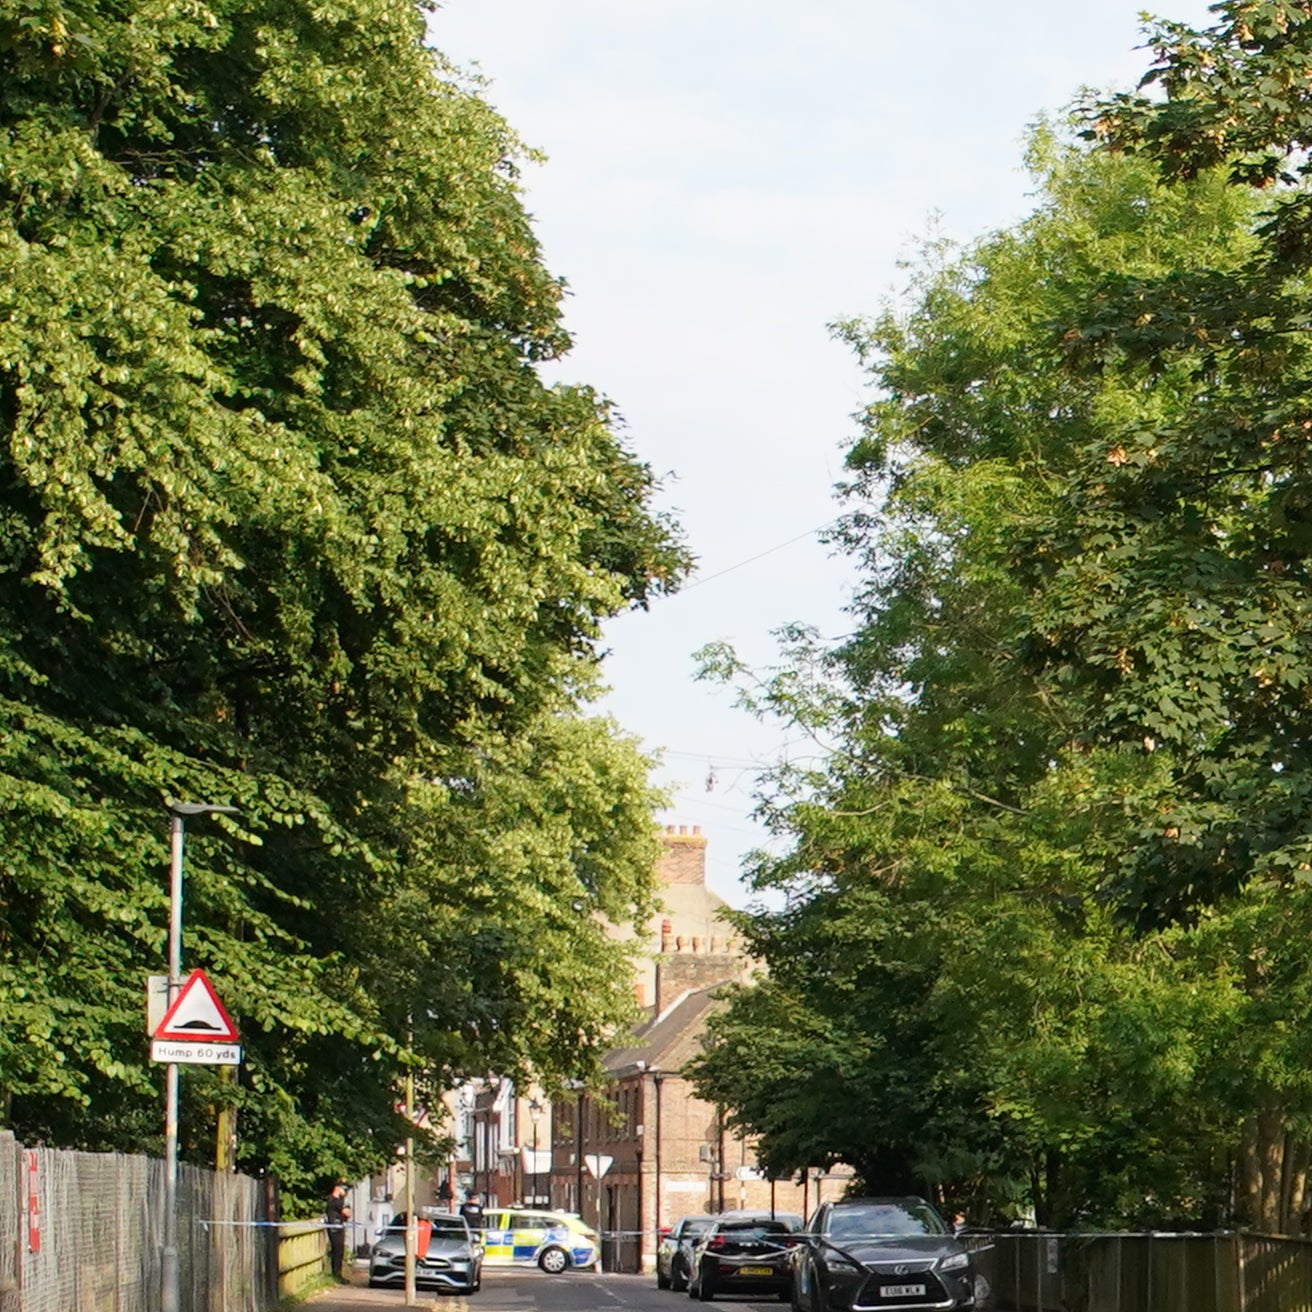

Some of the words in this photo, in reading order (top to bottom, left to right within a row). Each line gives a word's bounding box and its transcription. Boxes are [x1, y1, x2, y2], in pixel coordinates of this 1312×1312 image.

[158, 1047, 192, 1057] Hump
[197, 1048, 213, 1058] 60
[216, 1050, 236, 1060] yds
